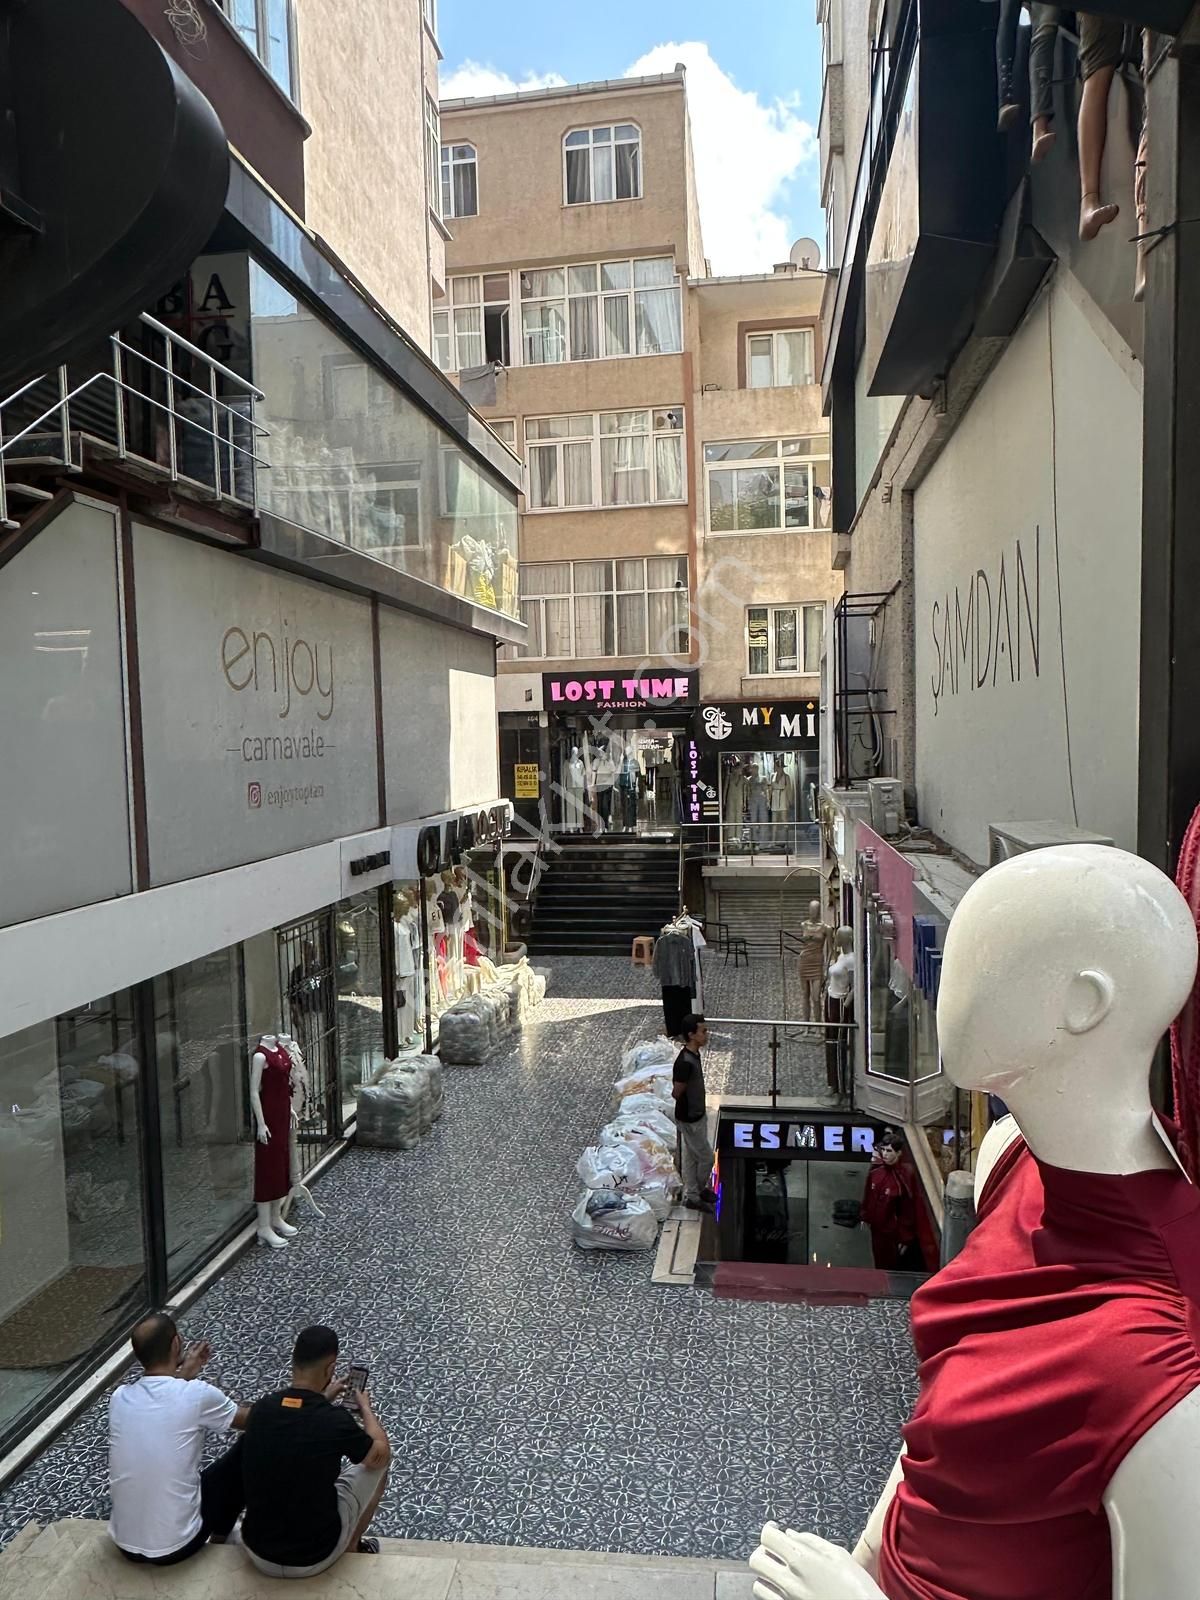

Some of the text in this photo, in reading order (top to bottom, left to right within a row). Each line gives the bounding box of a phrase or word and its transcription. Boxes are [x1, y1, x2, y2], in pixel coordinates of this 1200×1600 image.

[221, 618, 334, 721] enjoy
[550, 677, 690, 701] LOST TIME
[596, 700, 647, 709] FASHION
[742, 707, 774, 726] MY
[242, 728, 325, 762] carnavale
[689, 740, 699, 822] LOST TIME
[733, 1122, 875, 1153] ESMER
